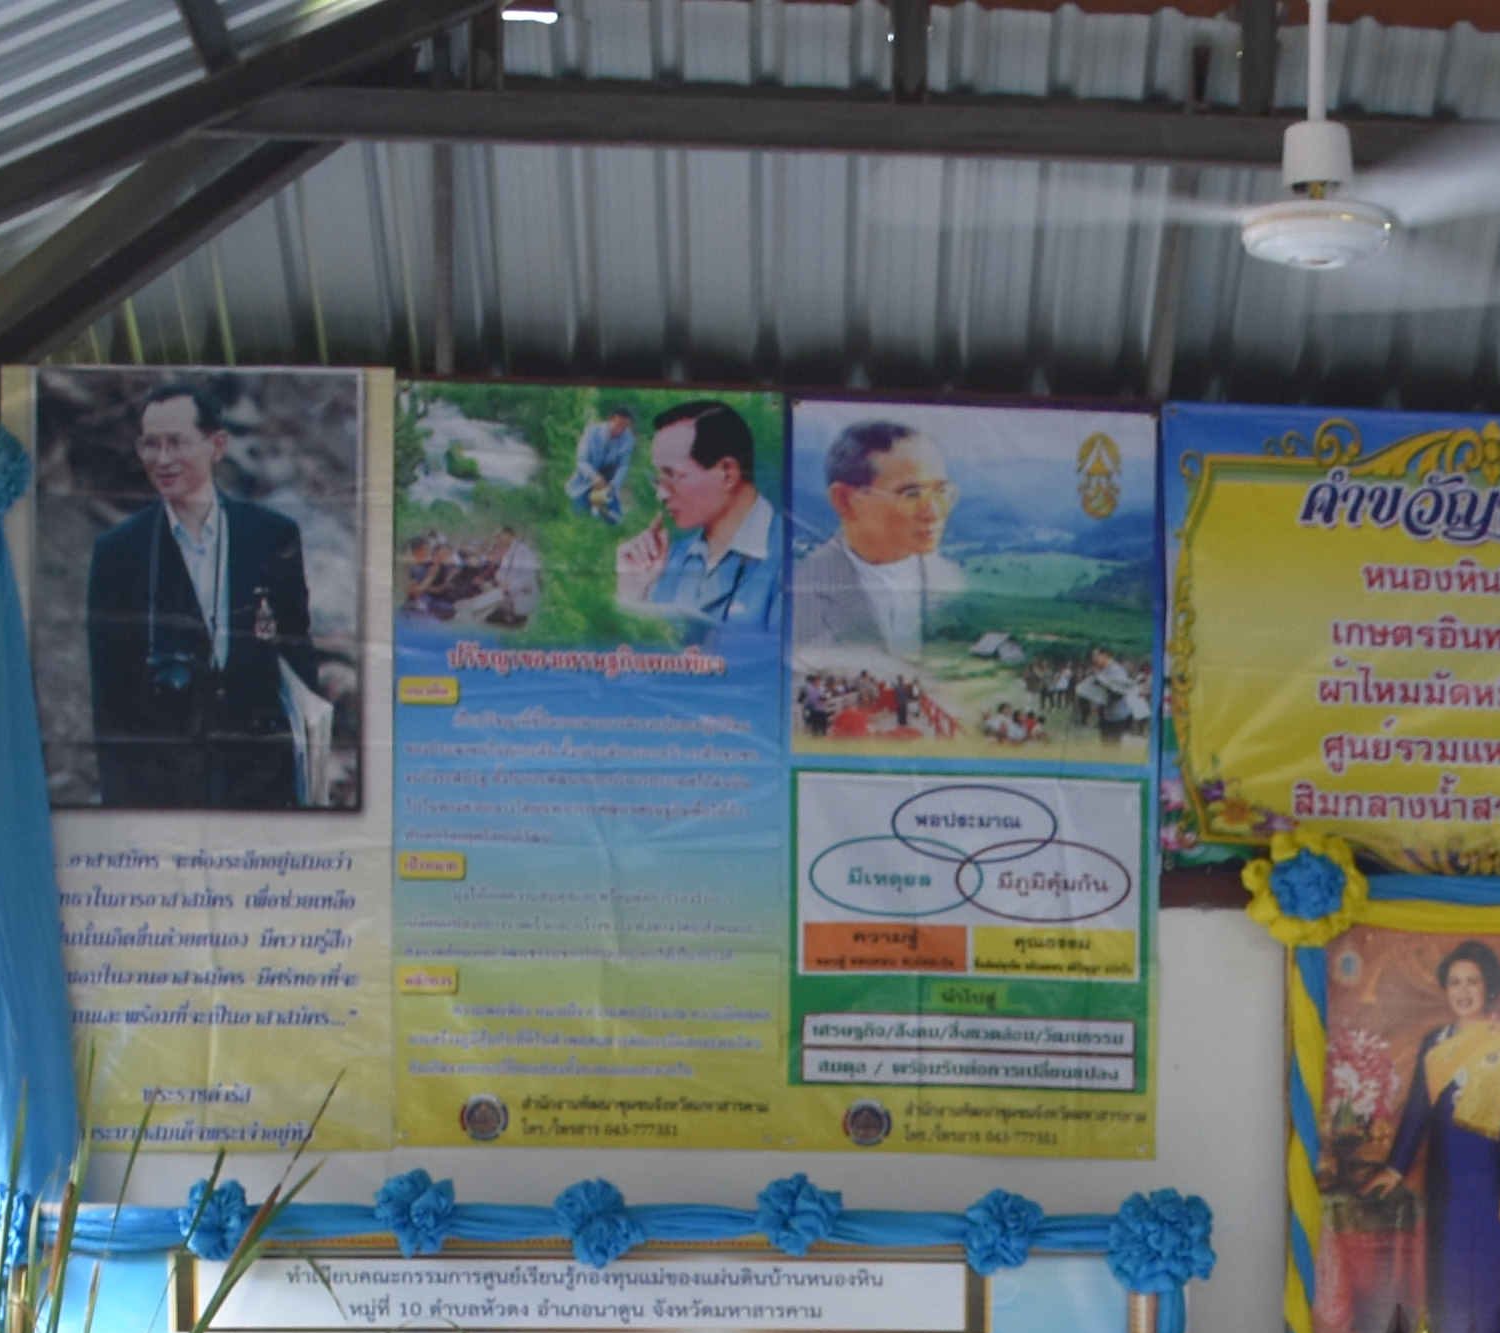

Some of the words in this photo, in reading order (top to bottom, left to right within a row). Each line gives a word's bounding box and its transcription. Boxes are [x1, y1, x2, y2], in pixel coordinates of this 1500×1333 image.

[914, 811, 1023, 830] พอประมาณ
[348, 1299, 390, 1324] หมู่ที่
[399, 1302, 422, 1317] 10
[429, 1299, 530, 1319] ตำบลหัวดง
[537, 1299, 646, 1325] อำเภอนาดูน
[652, 1298, 823, 1320] จังหวัดมหาสารคาม
